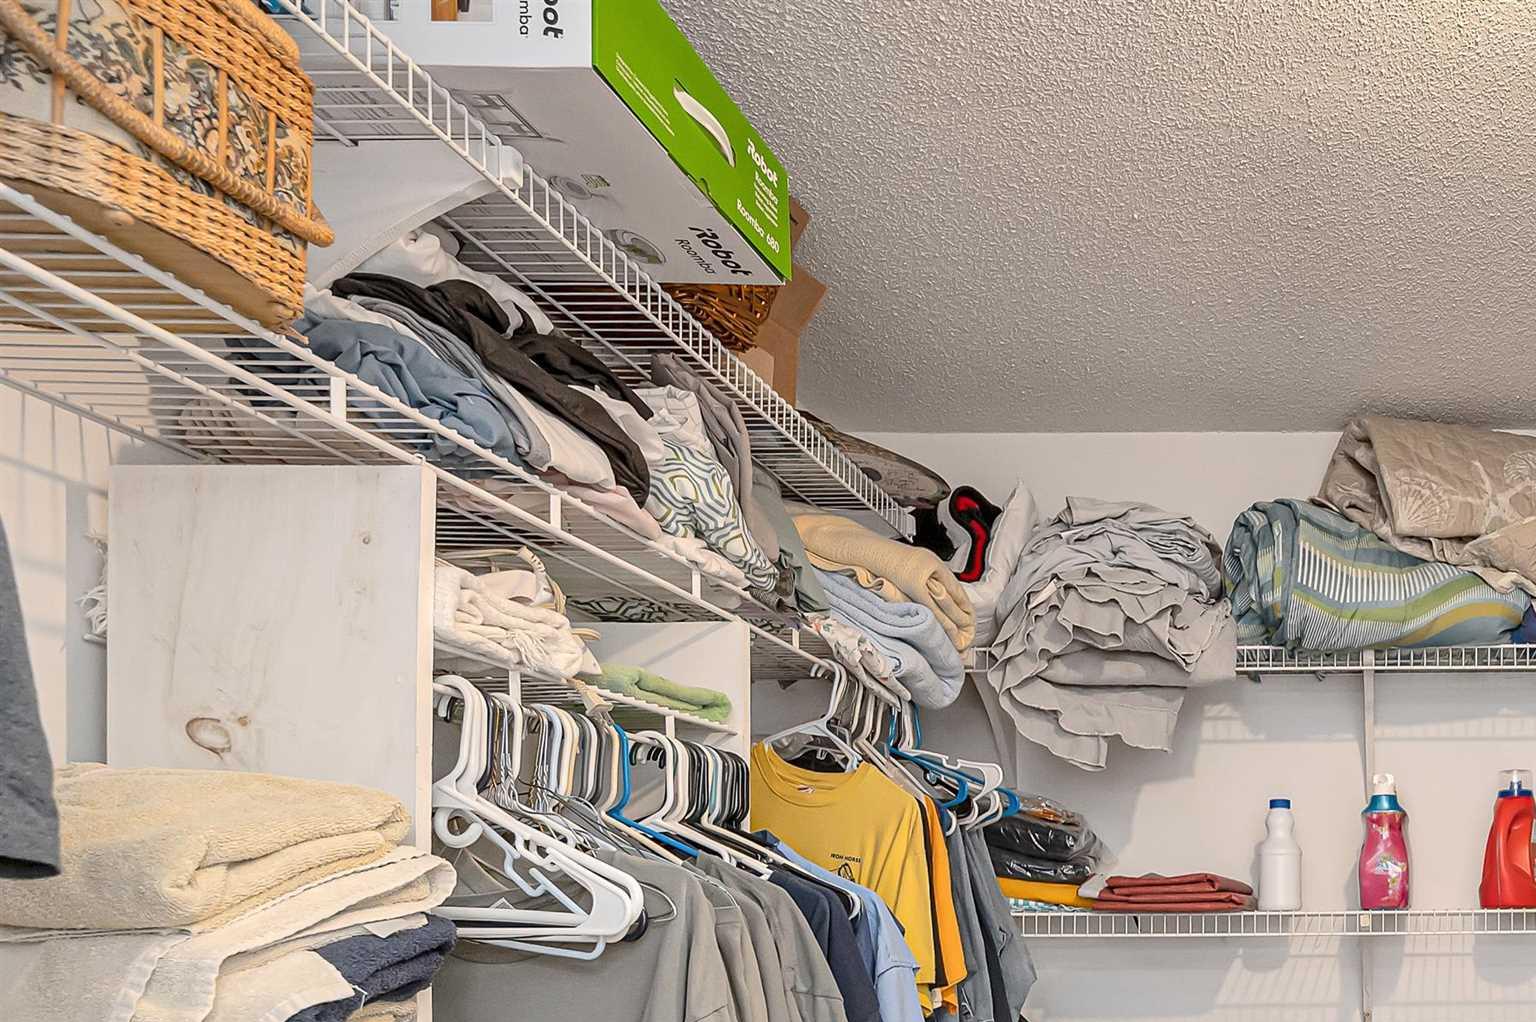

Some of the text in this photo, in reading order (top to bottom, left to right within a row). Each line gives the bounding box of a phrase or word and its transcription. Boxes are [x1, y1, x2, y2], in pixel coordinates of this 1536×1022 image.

[736, 198, 765, 239] Roomba
[674, 238, 717, 274] Roomba
[688, 226, 753, 276] iRobot
